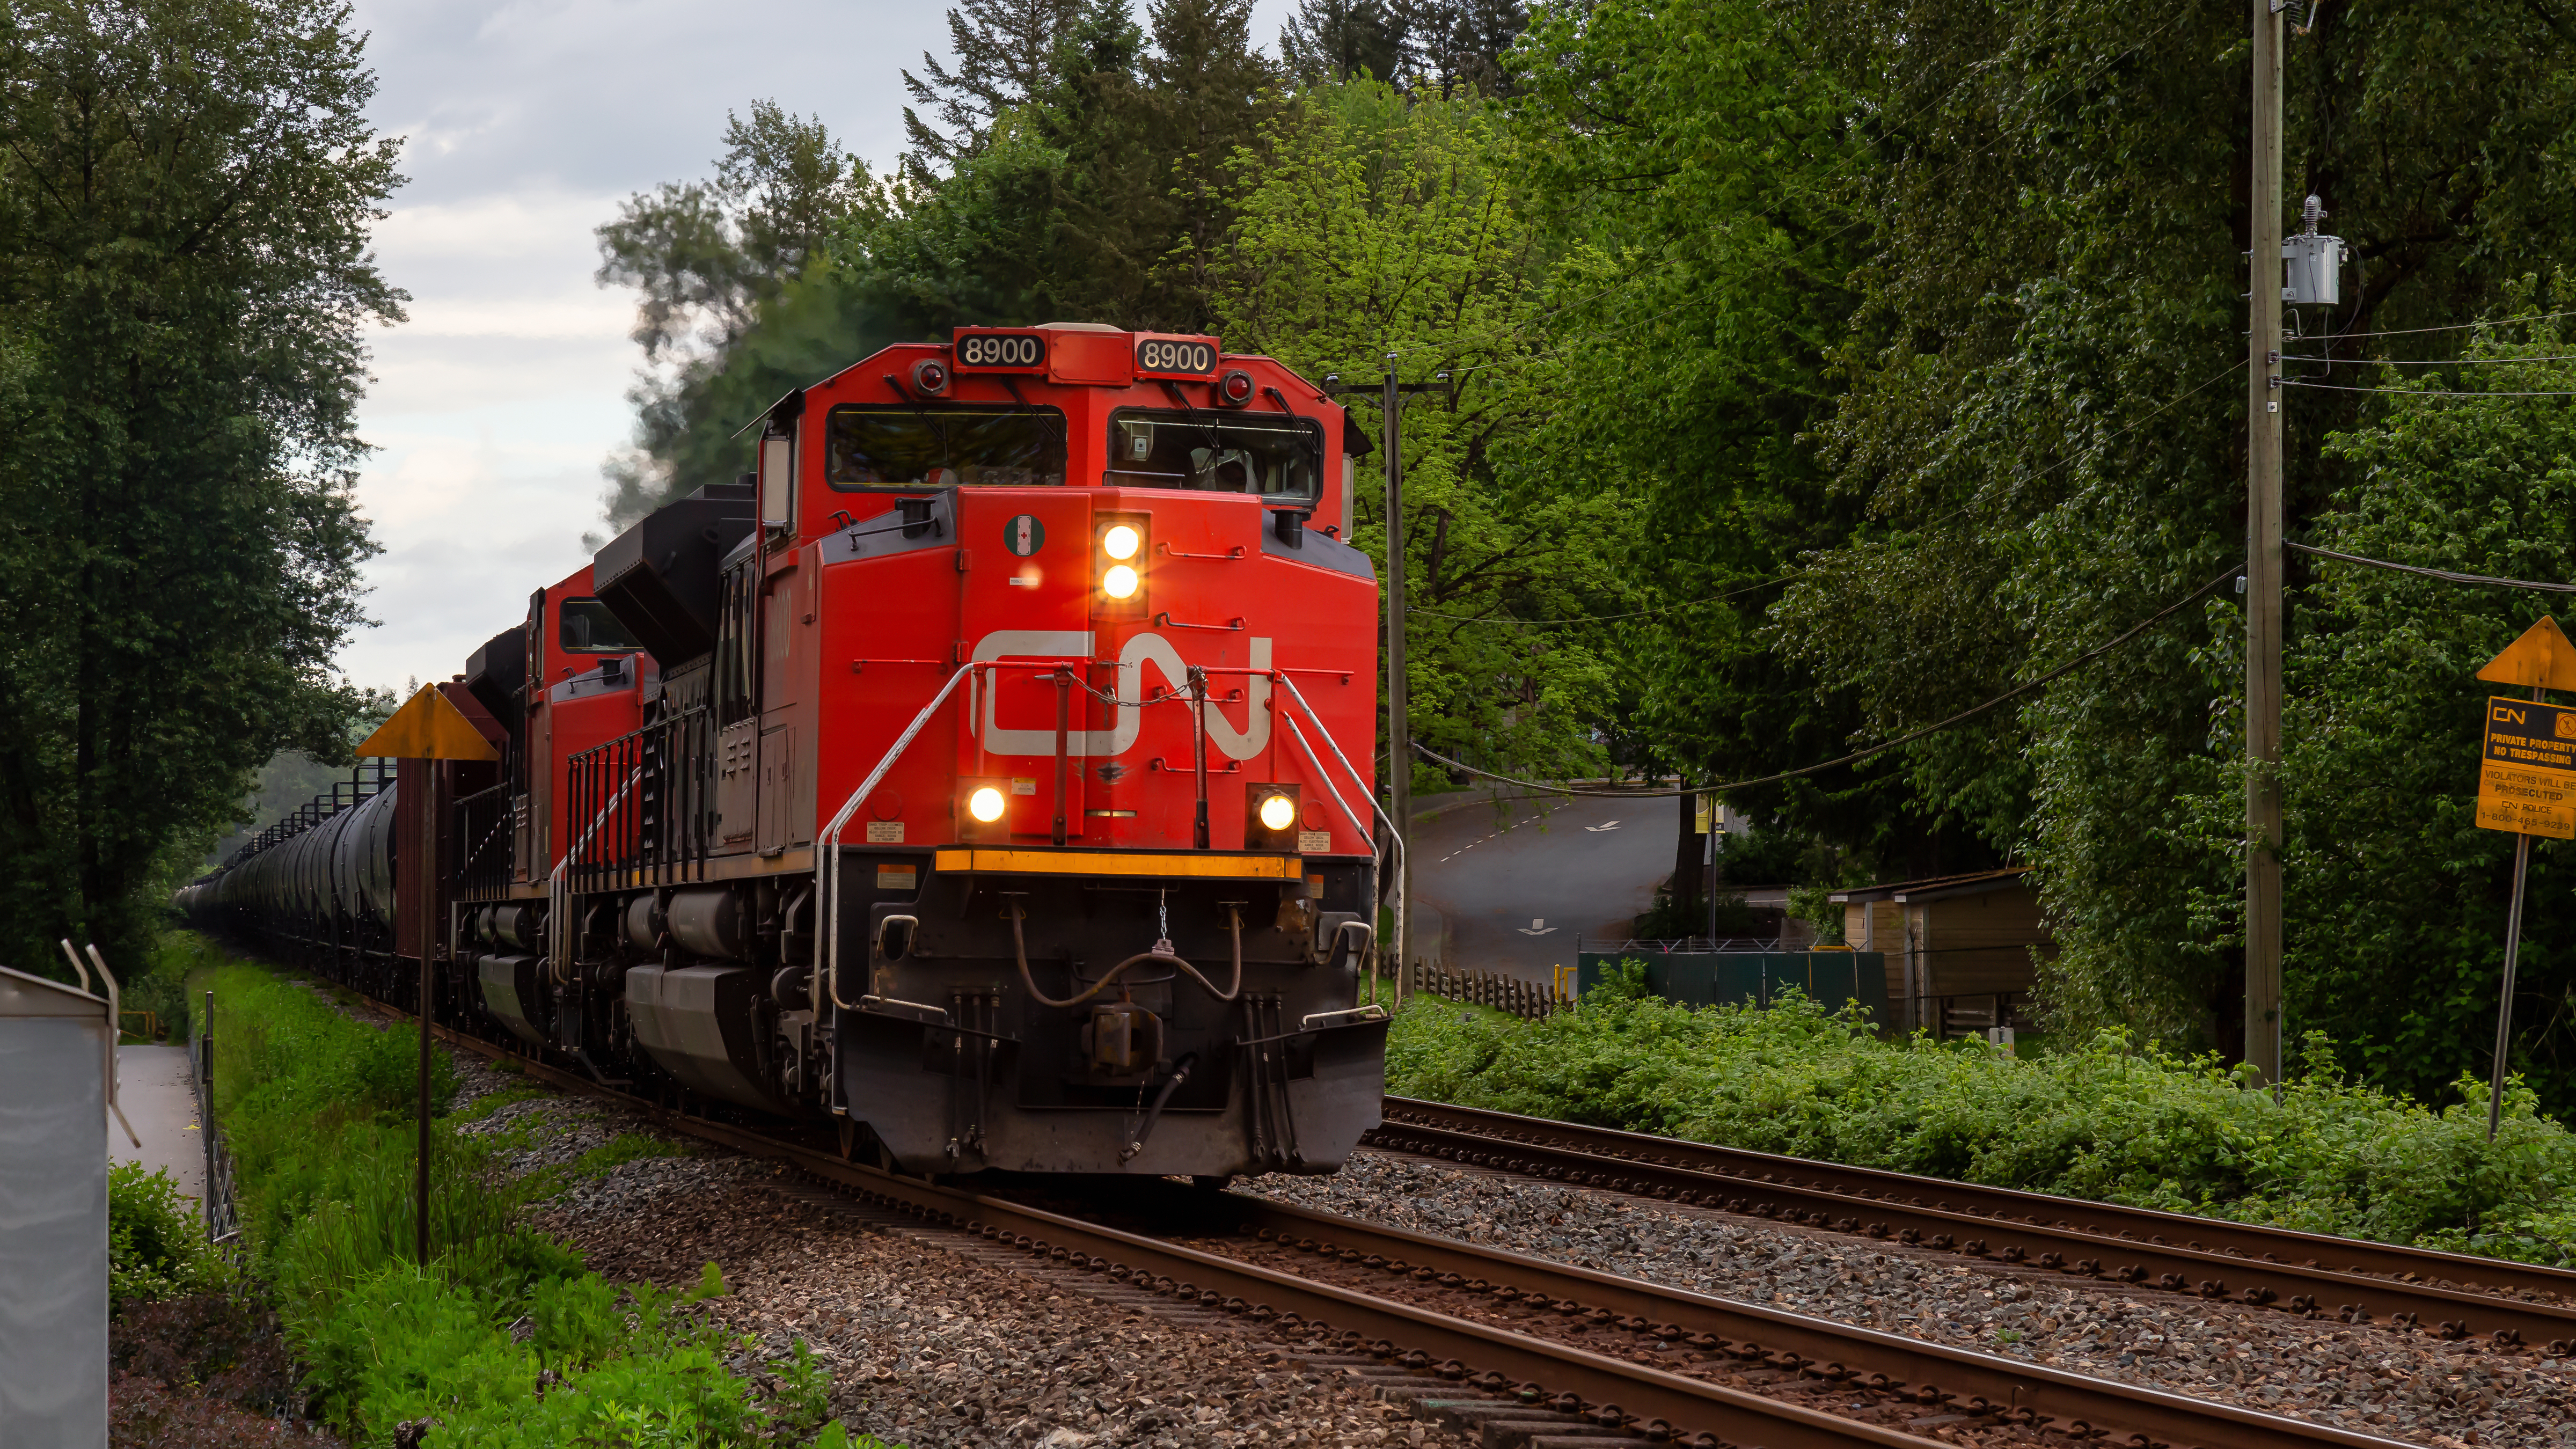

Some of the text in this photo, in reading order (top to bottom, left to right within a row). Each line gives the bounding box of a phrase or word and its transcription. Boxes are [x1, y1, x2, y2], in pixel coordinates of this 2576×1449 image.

[965, 338, 1036, 363] 8900
[1144, 342, 1208, 371] 8900
[970, 630, 1272, 761] CN
[2493, 707, 2526, 724] CN
[2491, 733, 2576, 753] PRIVATE PROPERTY
[2493, 745, 2572, 765] NO TRESPASSING
[2485, 770, 2537, 785] VIOLATORS
[2539, 777, 2562, 788] WILL
[2563, 781, 2576, 790] BE
[2495, 784, 2563, 801] PROSECUTED
[2501, 801, 2552, 814] CN POLICE
[2481, 811, 2571, 830] 1-800-465-9239
